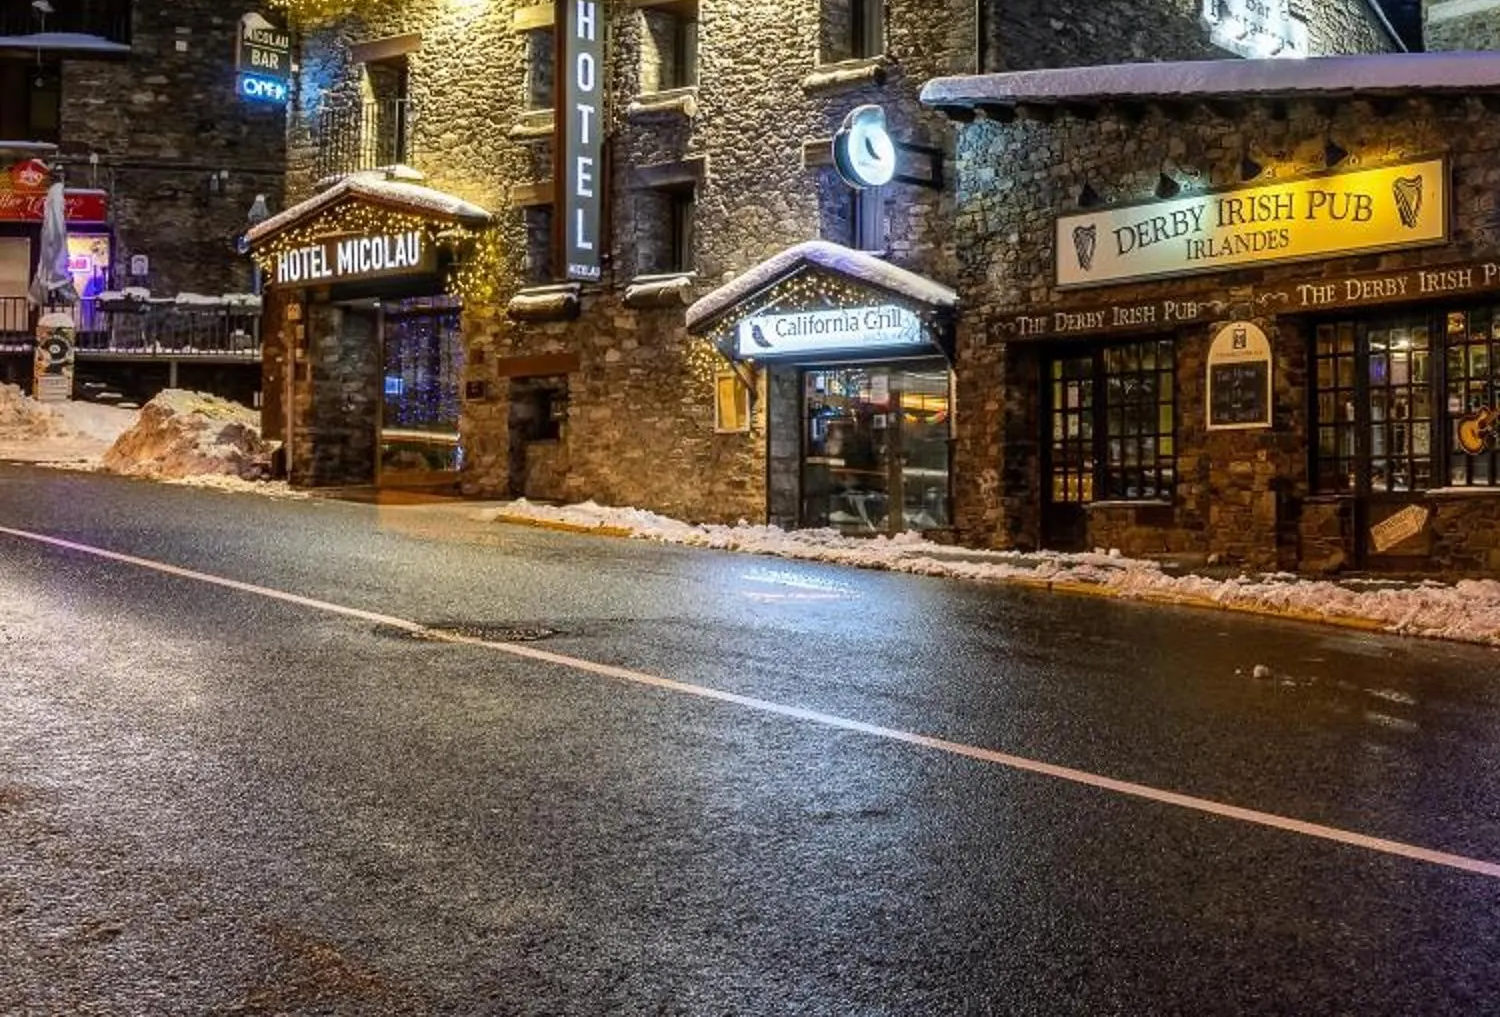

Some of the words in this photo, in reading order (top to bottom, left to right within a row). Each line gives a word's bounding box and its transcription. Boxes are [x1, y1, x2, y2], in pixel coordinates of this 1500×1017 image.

[251, 49, 279, 70] BAR
[243, 78, 287, 100] OPEN
[577, 0, 595, 250] HOTEL
[1112, 204, 1207, 256] DERBY
[1215, 191, 1294, 229] IRISH
[1305, 190, 1374, 222] PUB
[277, 243, 332, 283] HOTEL
[337, 231, 421, 275] MICOLAU
[1186, 228, 1290, 260] IRLANDES
[1296, 283, 1335, 306] THE
[1345, 277, 1409, 301] DERBY
[1418, 269, 1473, 293] IRISH
[775, 313, 859, 337] California
[863, 306, 903, 330] Grill
[1016, 315, 1048, 336] THE
[1054, 310, 1106, 333] DERBY
[1111, 305, 1156, 327] IRISH
[1163, 300, 1199, 321] PUB
